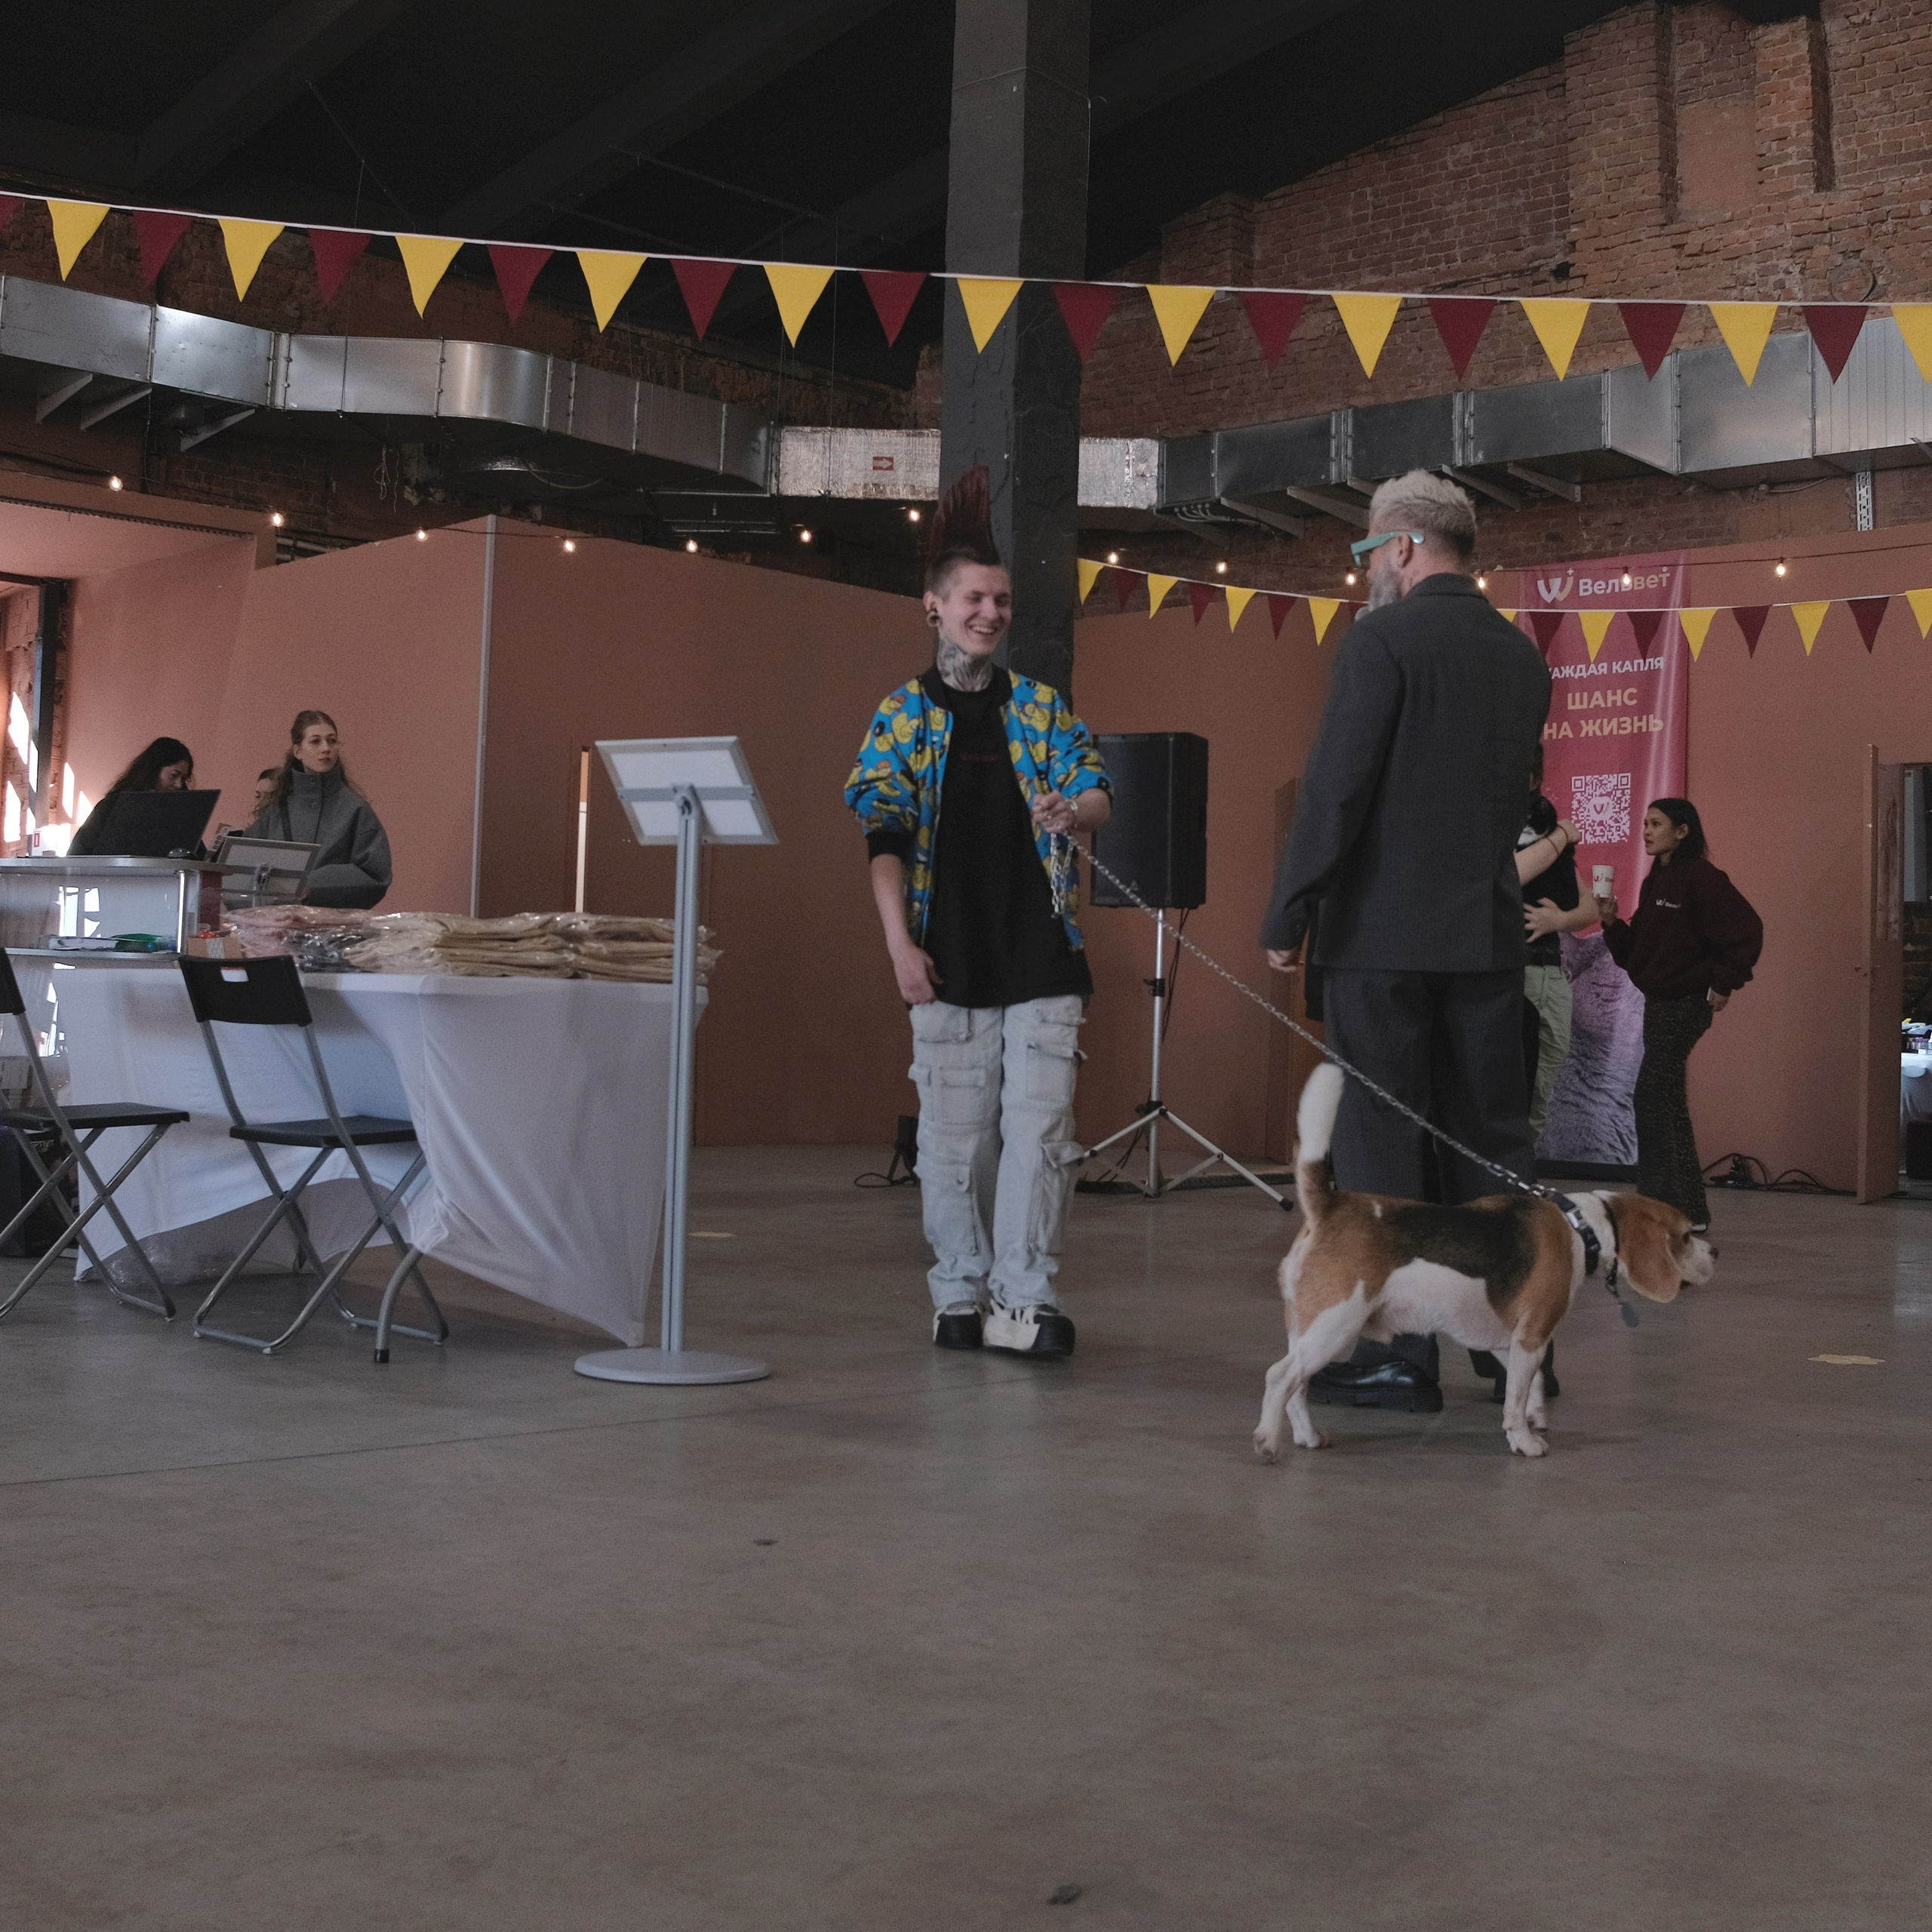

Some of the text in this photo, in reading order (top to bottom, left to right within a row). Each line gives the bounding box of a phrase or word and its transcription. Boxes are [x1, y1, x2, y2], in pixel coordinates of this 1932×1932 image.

[1549, 657, 1665, 679] АЖДАЯ КАПЛЯ
[1567, 688, 1638, 710] ШАНС
[1543, 714, 1664, 740] НА ЖИЗНЬ
